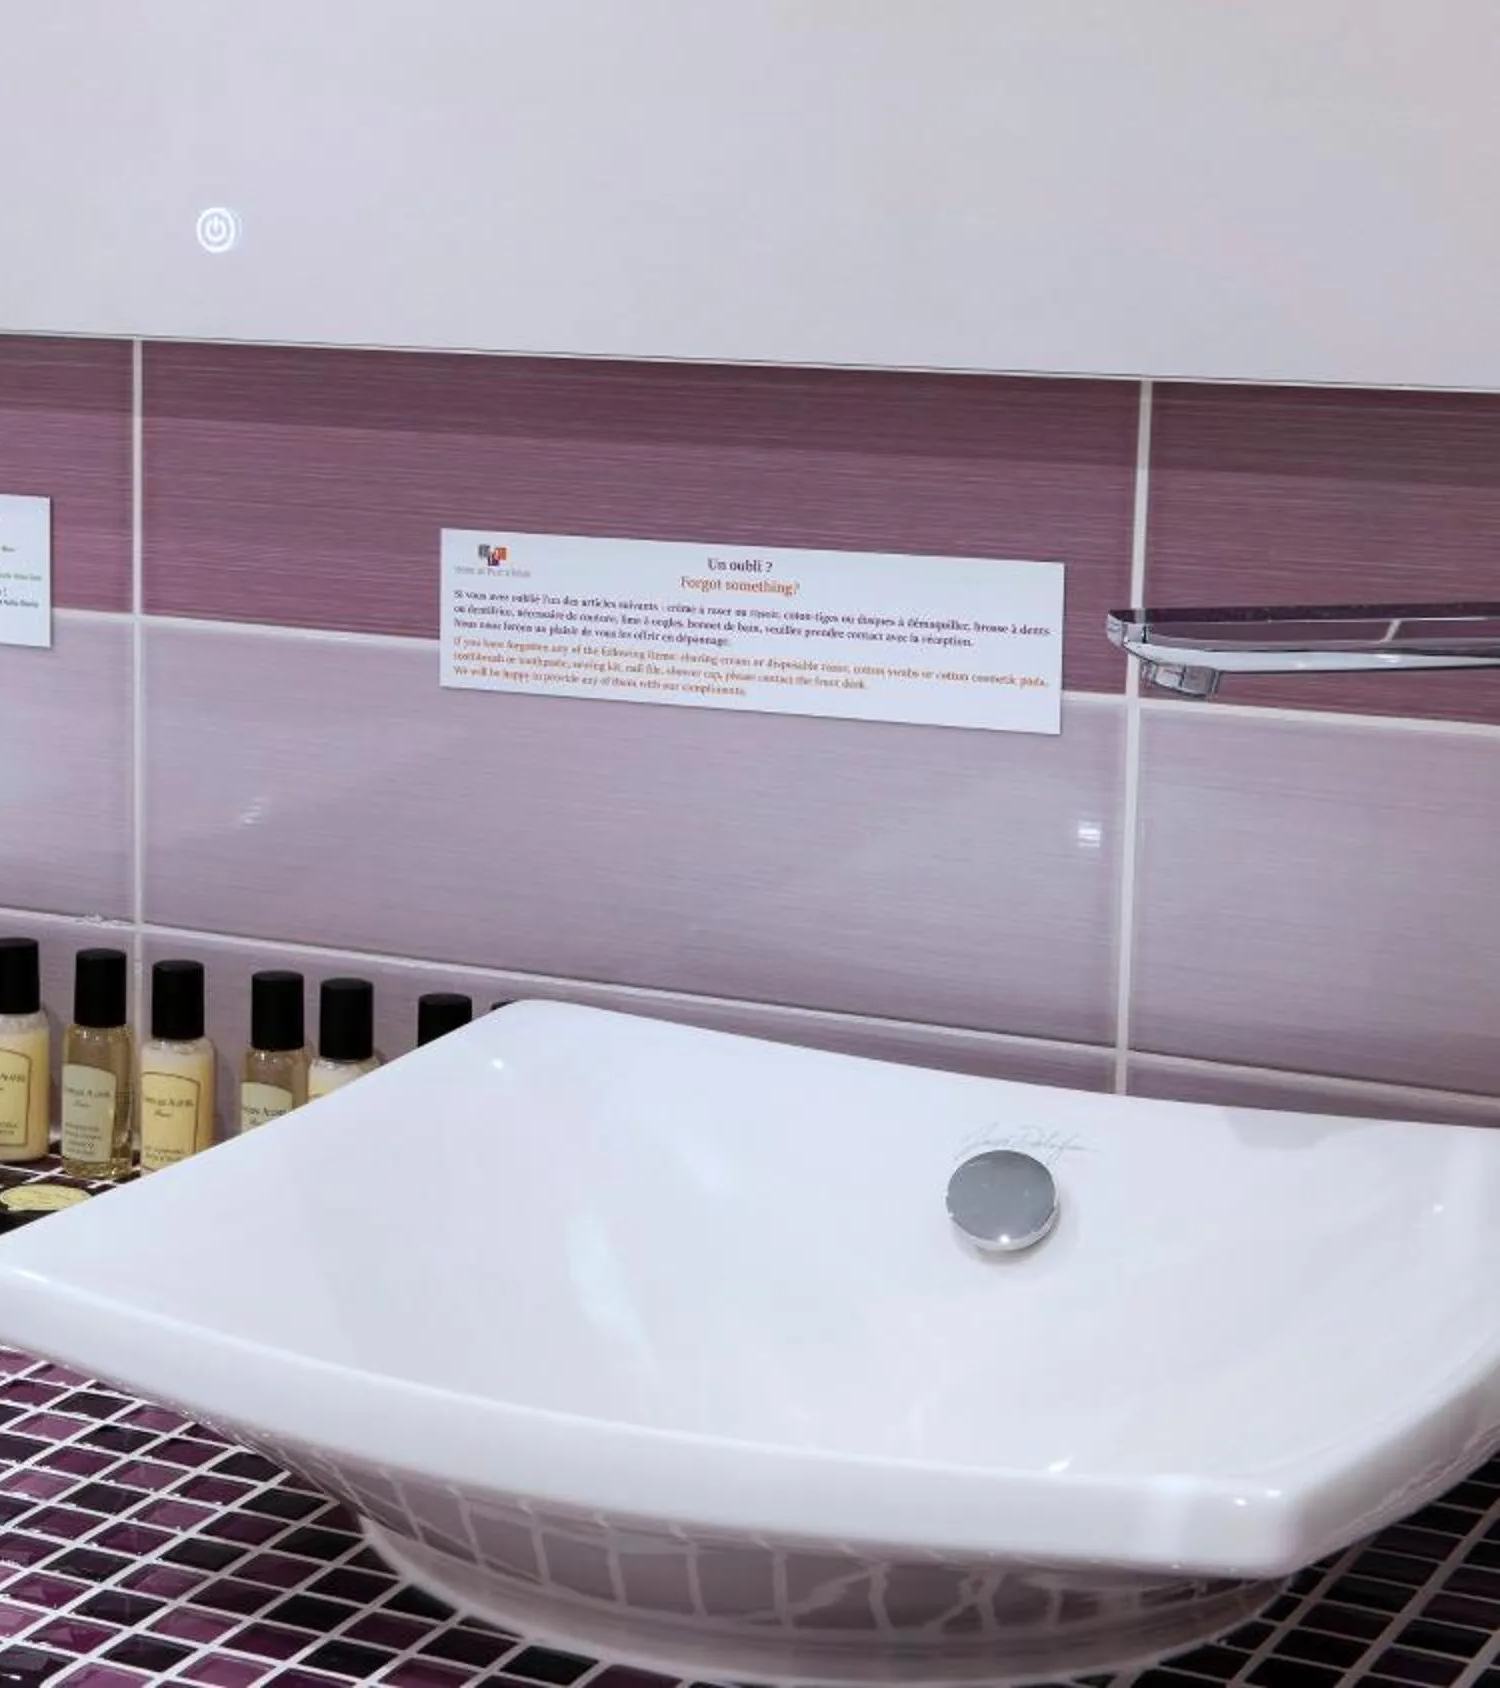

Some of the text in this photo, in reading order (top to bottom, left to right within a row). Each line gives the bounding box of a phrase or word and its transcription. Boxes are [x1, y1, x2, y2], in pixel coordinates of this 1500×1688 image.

[707, 557, 773, 573] Un oubli ?
[680, 575, 800, 597] Forgot something?
